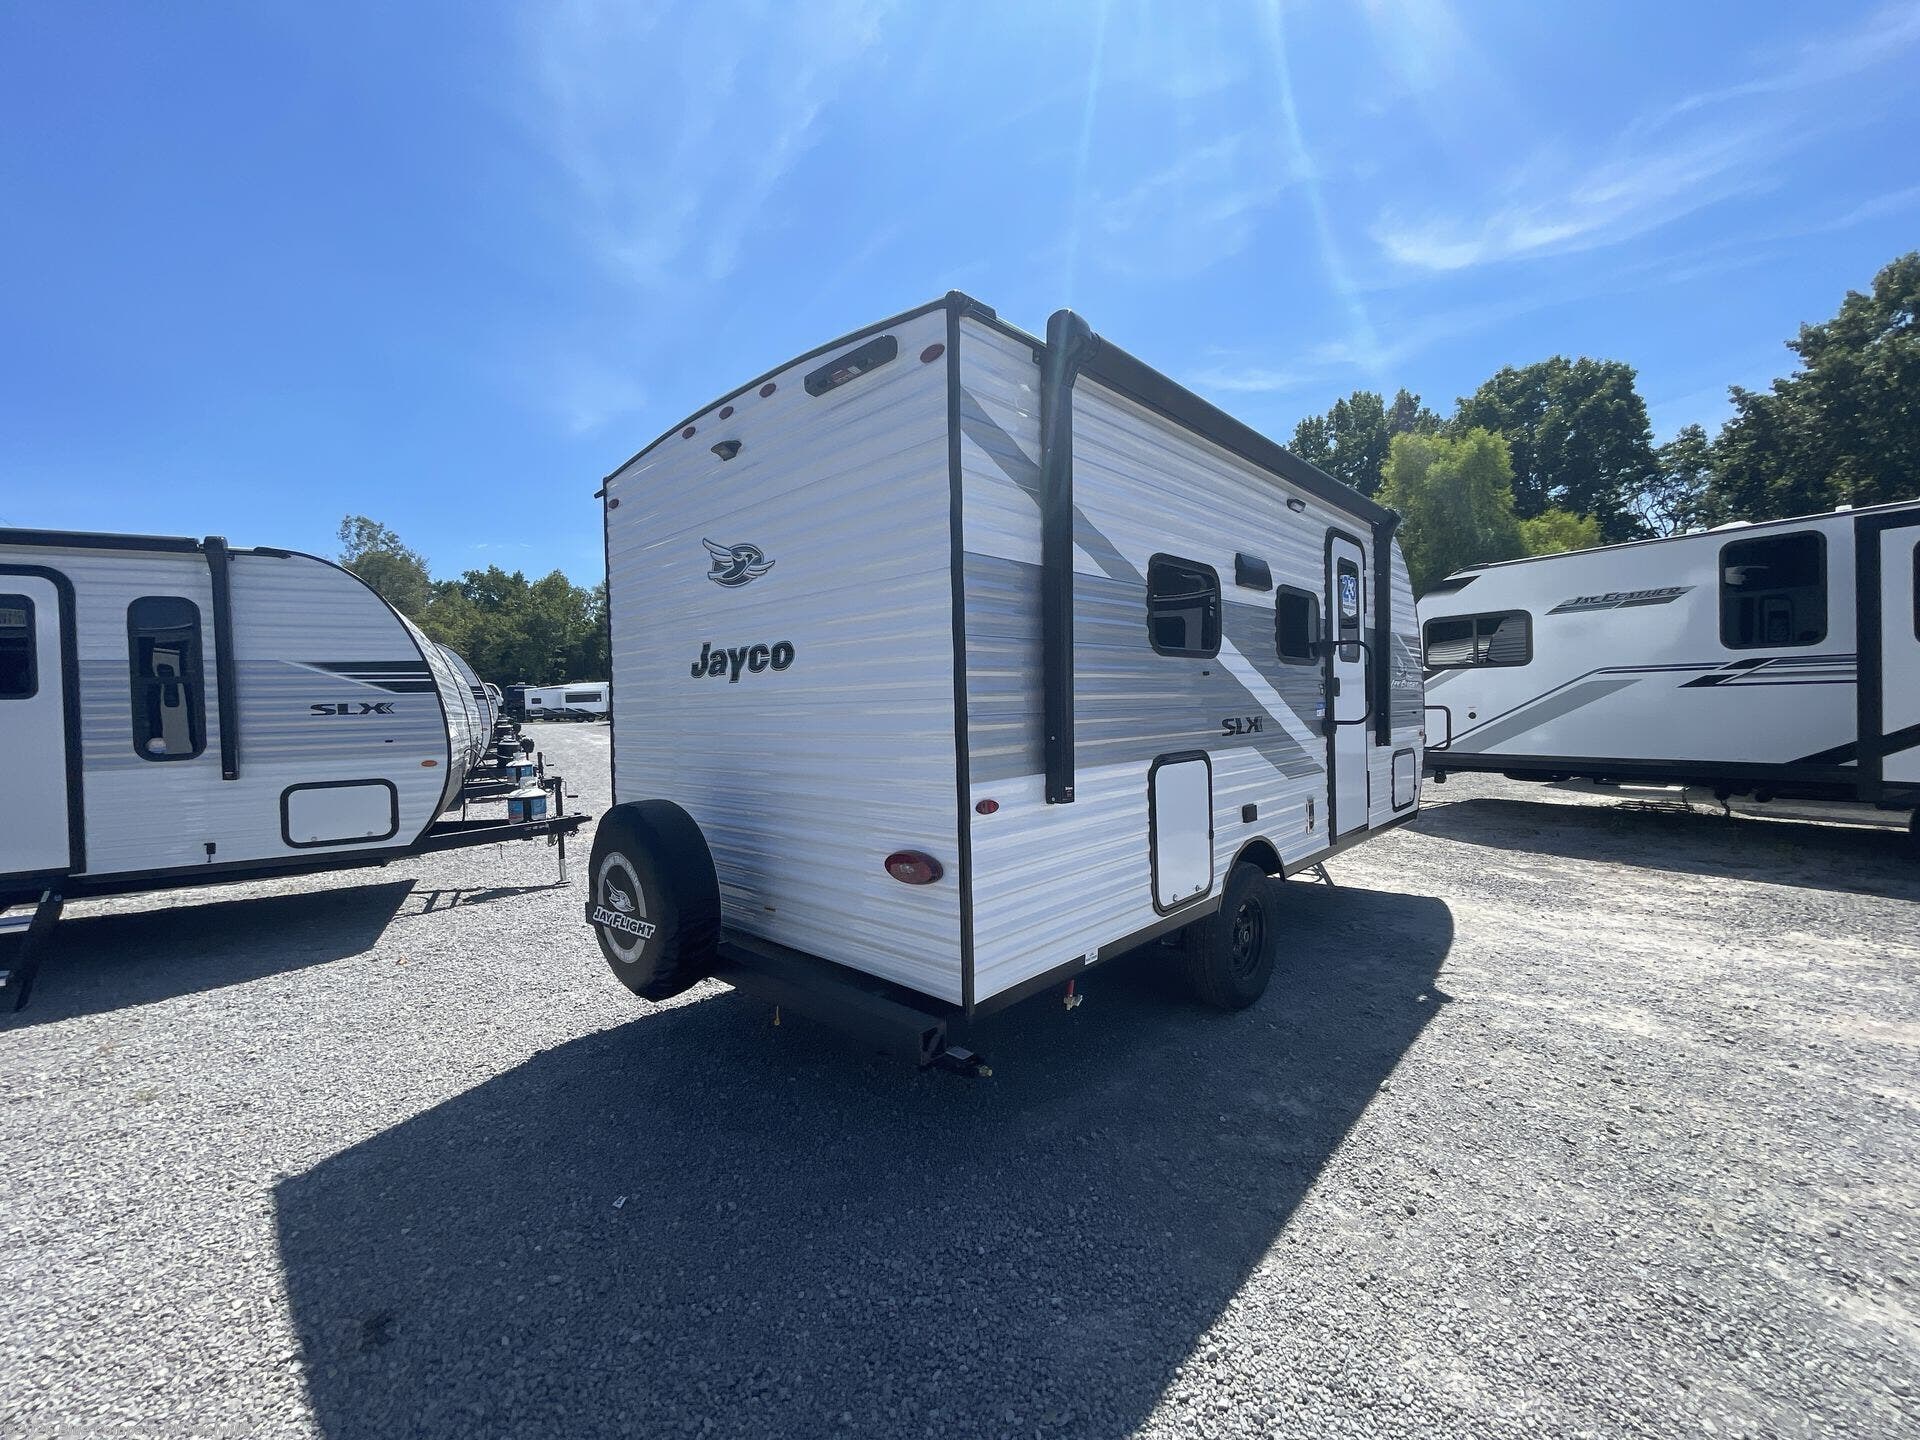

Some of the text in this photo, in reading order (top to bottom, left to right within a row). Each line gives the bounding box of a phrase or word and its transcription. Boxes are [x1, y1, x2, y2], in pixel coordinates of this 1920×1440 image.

[690, 640, 796, 684] Jayco
[310, 702, 395, 716] SLX
[1221, 716, 1263, 737] SLX
[593, 906, 656, 939] JAY FLIGHT
